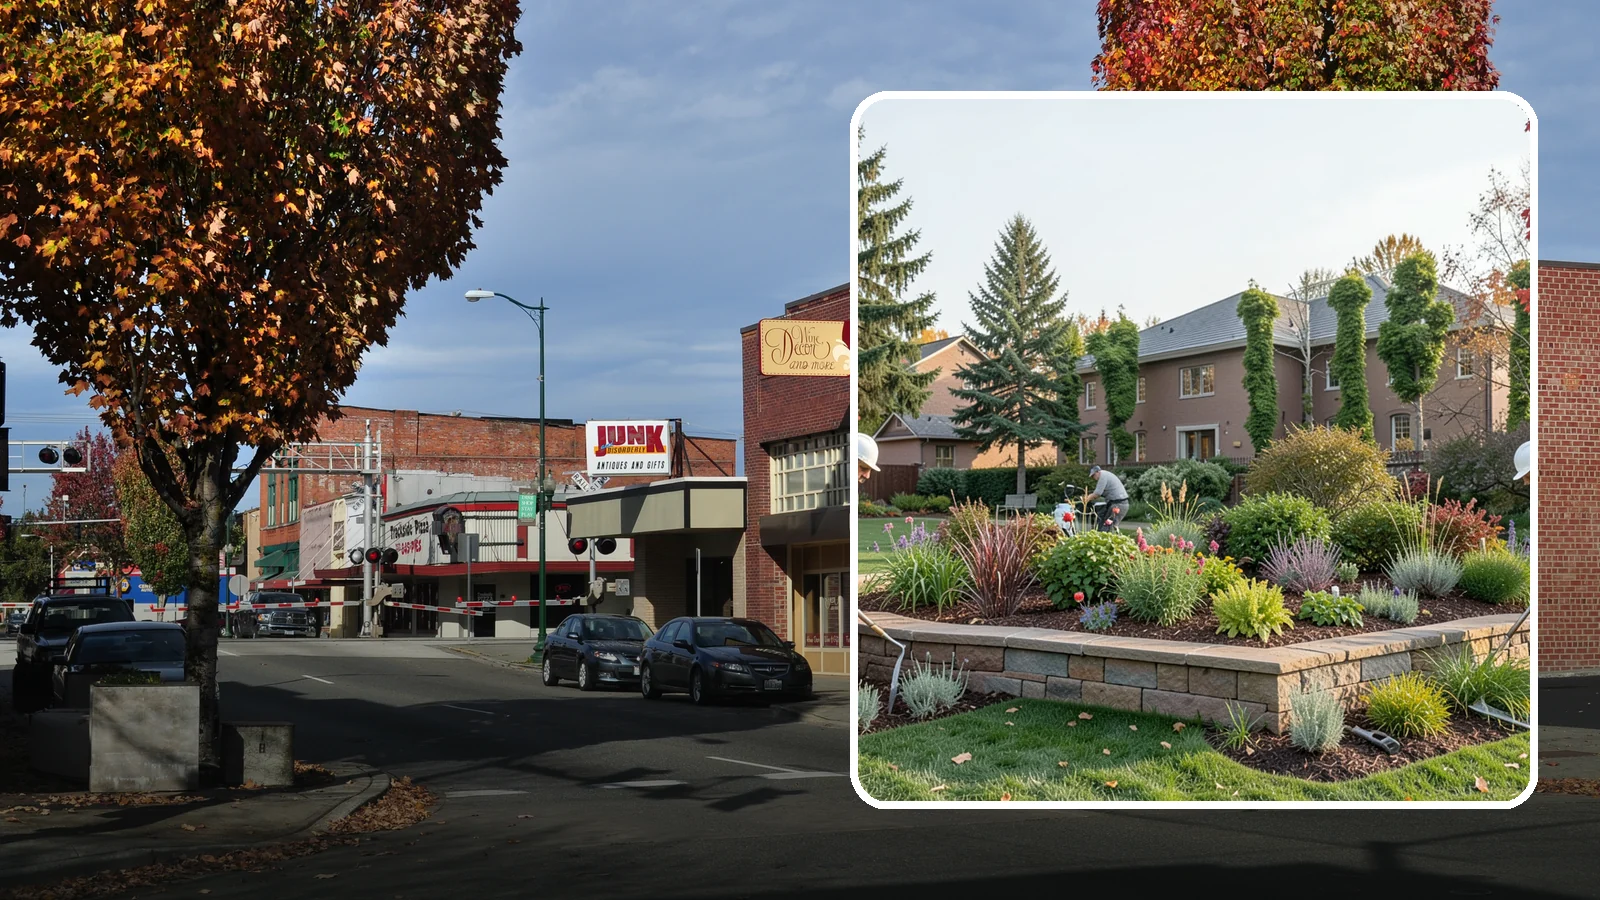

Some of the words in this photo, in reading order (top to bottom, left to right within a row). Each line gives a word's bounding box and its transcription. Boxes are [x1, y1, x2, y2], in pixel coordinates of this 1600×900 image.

[595, 425, 665, 457] JUNK
[607, 446, 646, 454] DISORDERLY
[596, 461, 628, 470] ANTIQUES
[631, 461, 644, 470] AND
[647, 460, 665, 470] GIFTS
[414, 519, 429, 535] Pizza
